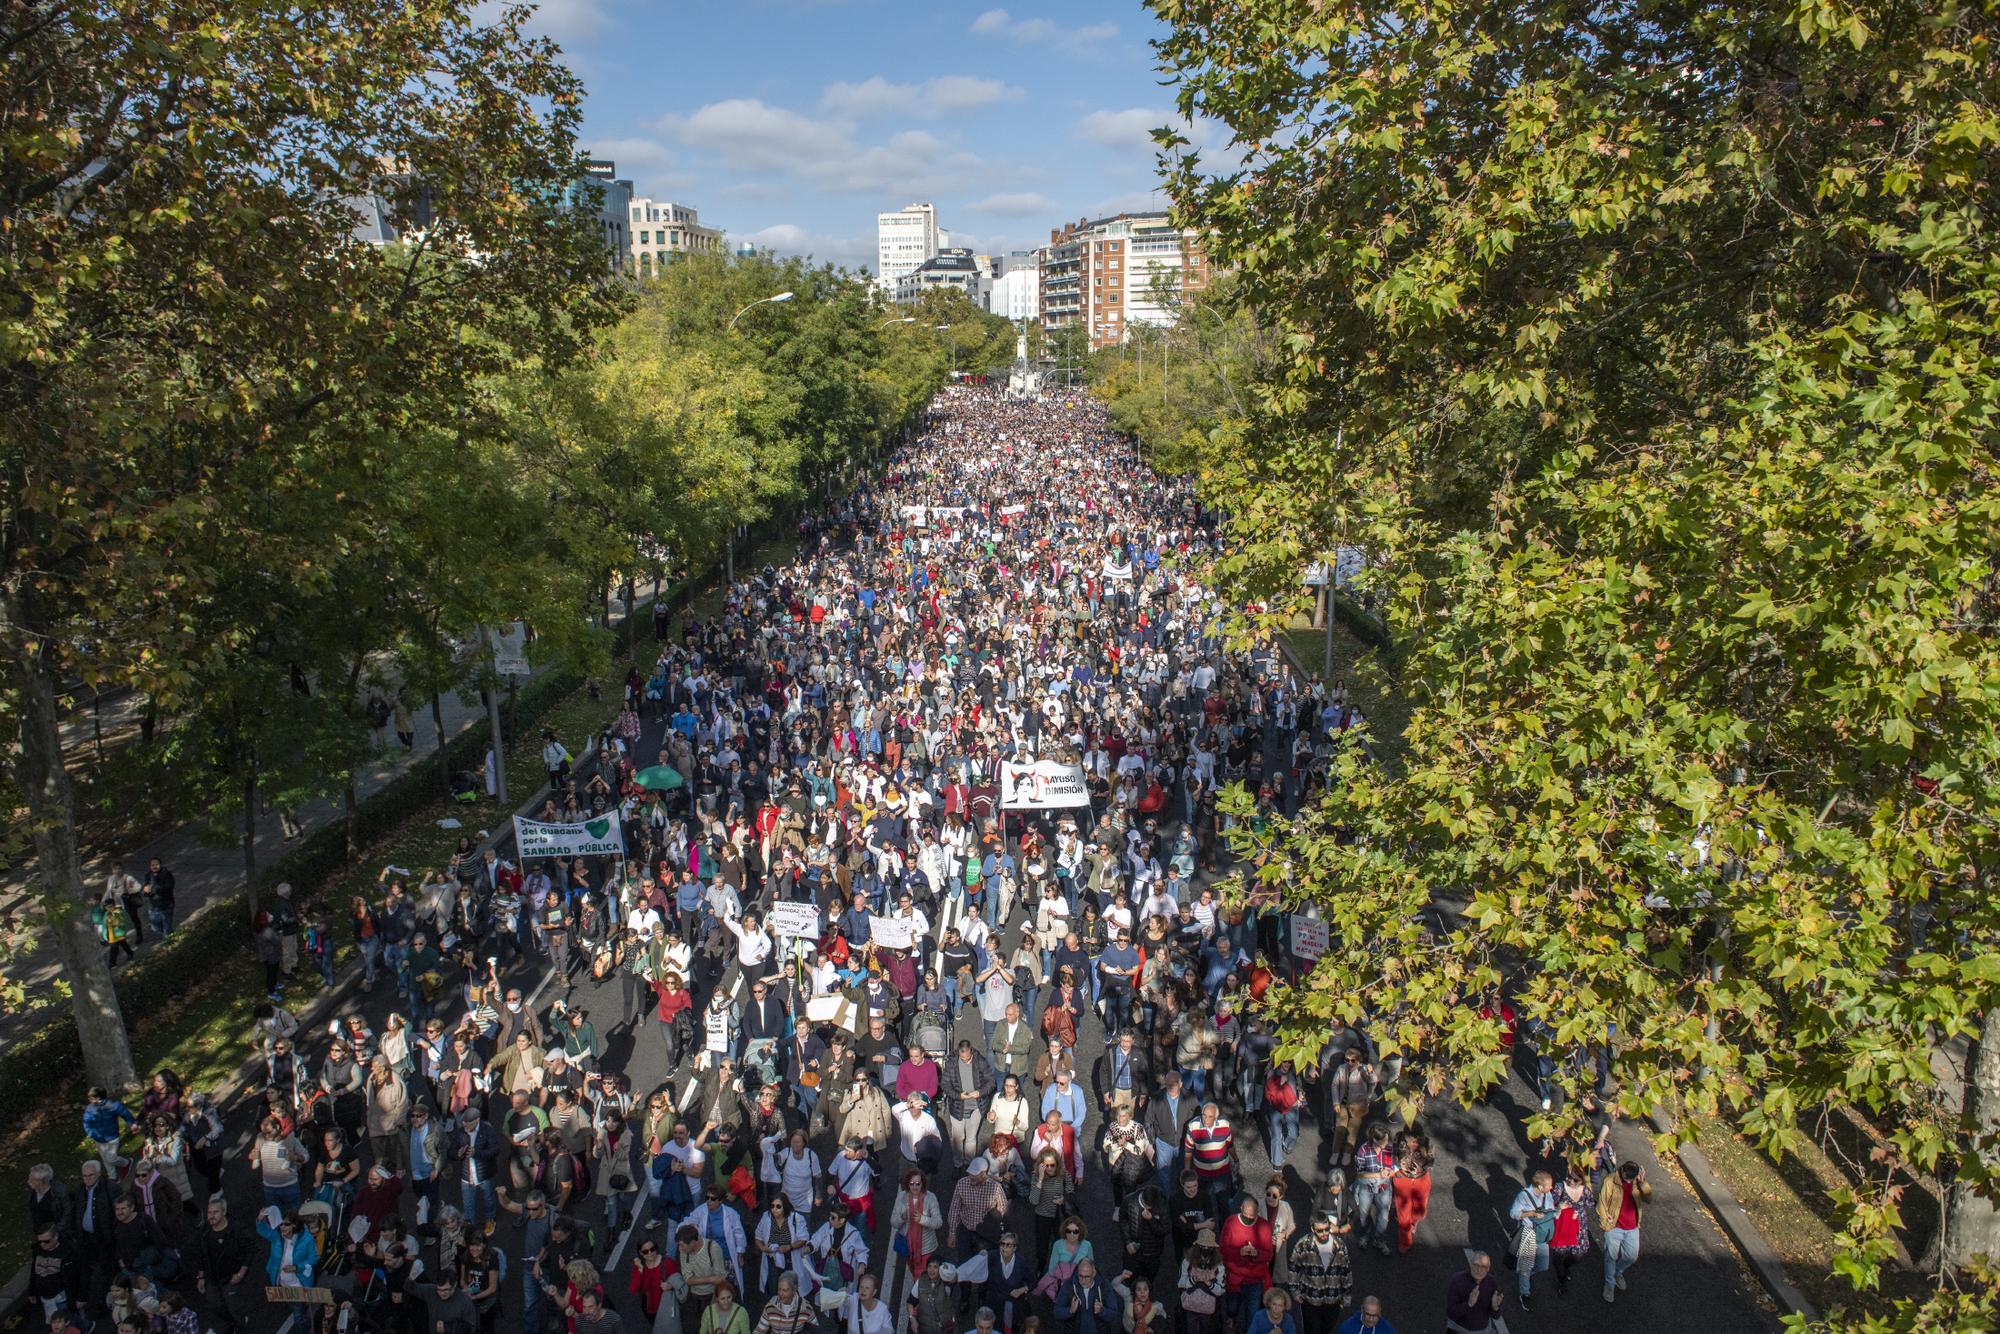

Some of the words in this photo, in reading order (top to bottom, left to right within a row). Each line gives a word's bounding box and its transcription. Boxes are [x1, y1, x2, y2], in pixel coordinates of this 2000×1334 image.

[1050, 775, 1076, 783] AYUSO
[1045, 785, 1084, 795] DIMISIÓN
[522, 827, 538, 835] del
[540, 827, 584, 835] Guadalix
[523, 837, 538, 846] por
[523, 846, 571, 855] SANIDAD
[578, 842, 620, 853] PÚBLICA
